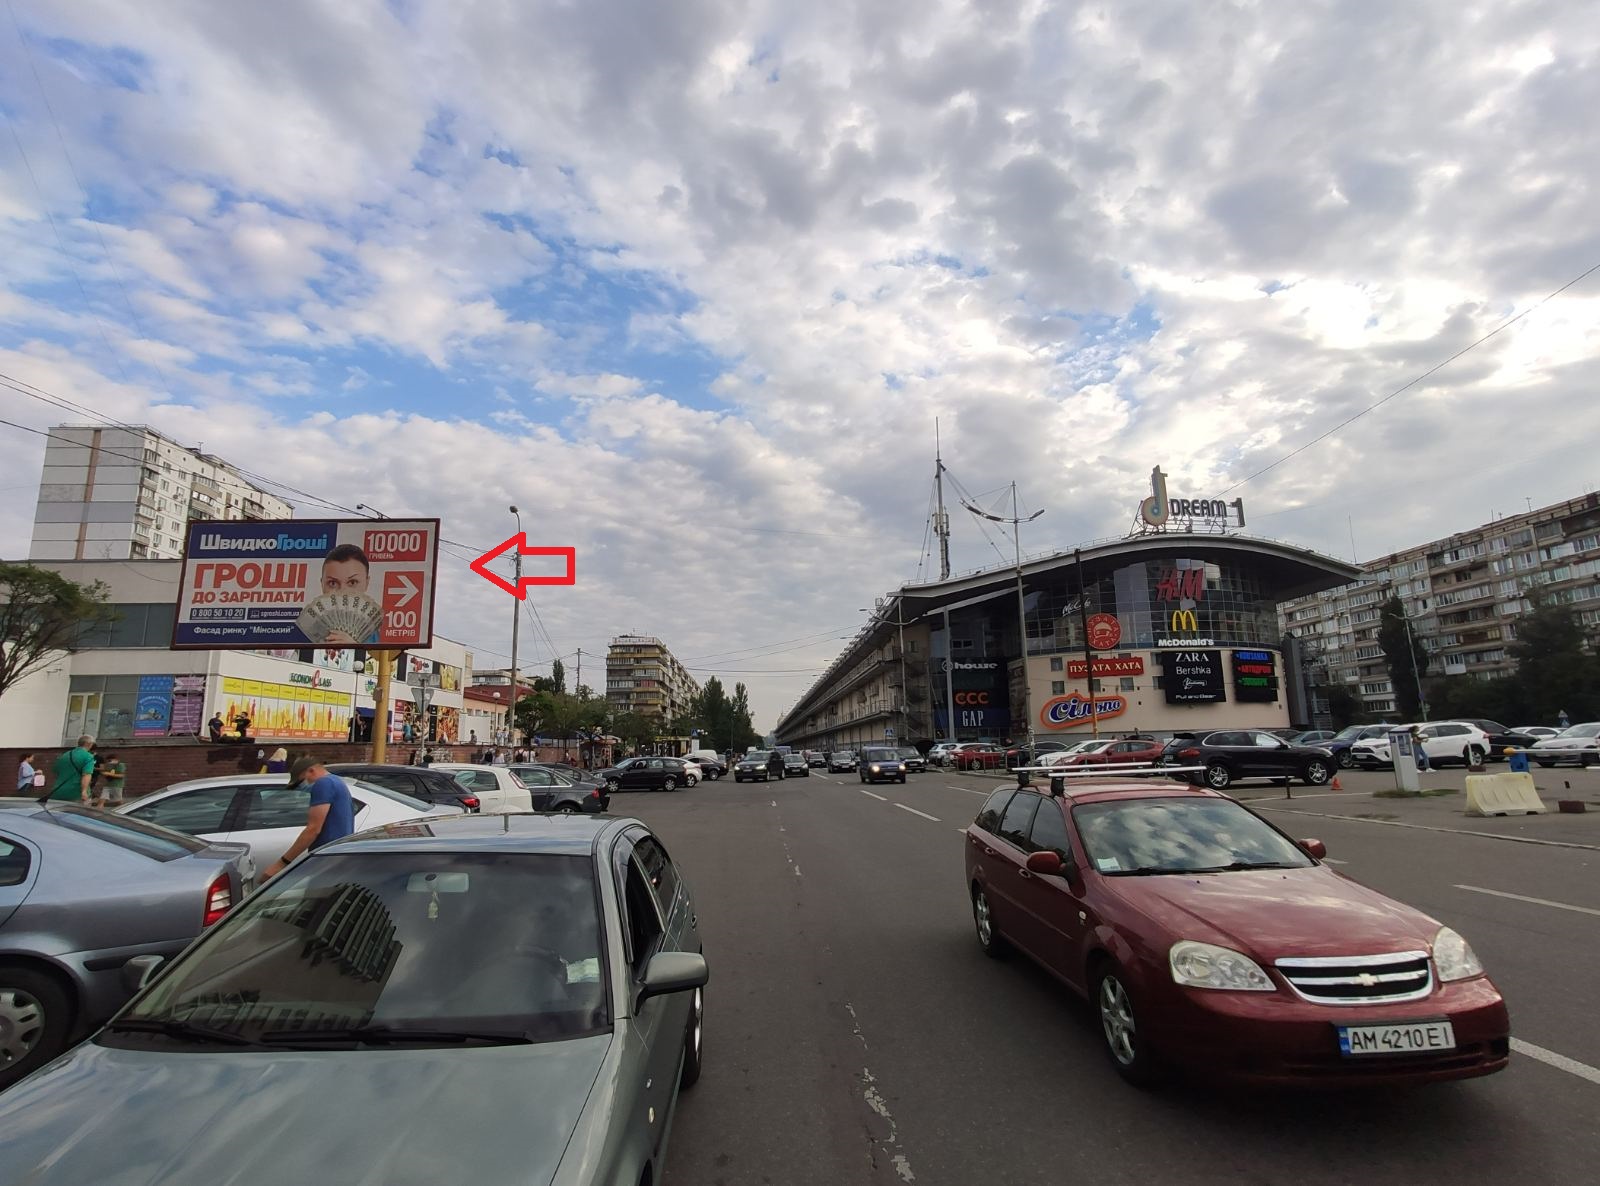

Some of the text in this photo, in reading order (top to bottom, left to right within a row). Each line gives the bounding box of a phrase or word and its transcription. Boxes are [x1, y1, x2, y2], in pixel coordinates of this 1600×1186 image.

[1169, 498, 1227, 517] DREAM
[200, 534, 327, 552] ШвидкоГроші
[194, 563, 308, 589] ГРОШІ
[192, 591, 305, 604] ДО ЗАРПЛАТИ
[192, 609, 244, 617] 0 800 50 10 20
[385, 611, 416, 628] 100
[193, 625, 295, 636] Фасад ринку "Мінський"
[385, 629, 416, 637] МЕТРІВ
[1158, 638, 1214, 647] McDonald's
[1175, 652, 1209, 662] ZARA
[1115, 661, 1141, 671] ХАТА
[1176, 665, 1212, 675] Bershka
[955, 692, 989, 705] CCC
[962, 711, 984, 727] GAP
[1351, 1030, 1378, 1050] AM
[1381, 1028, 1425, 1048] 4210
